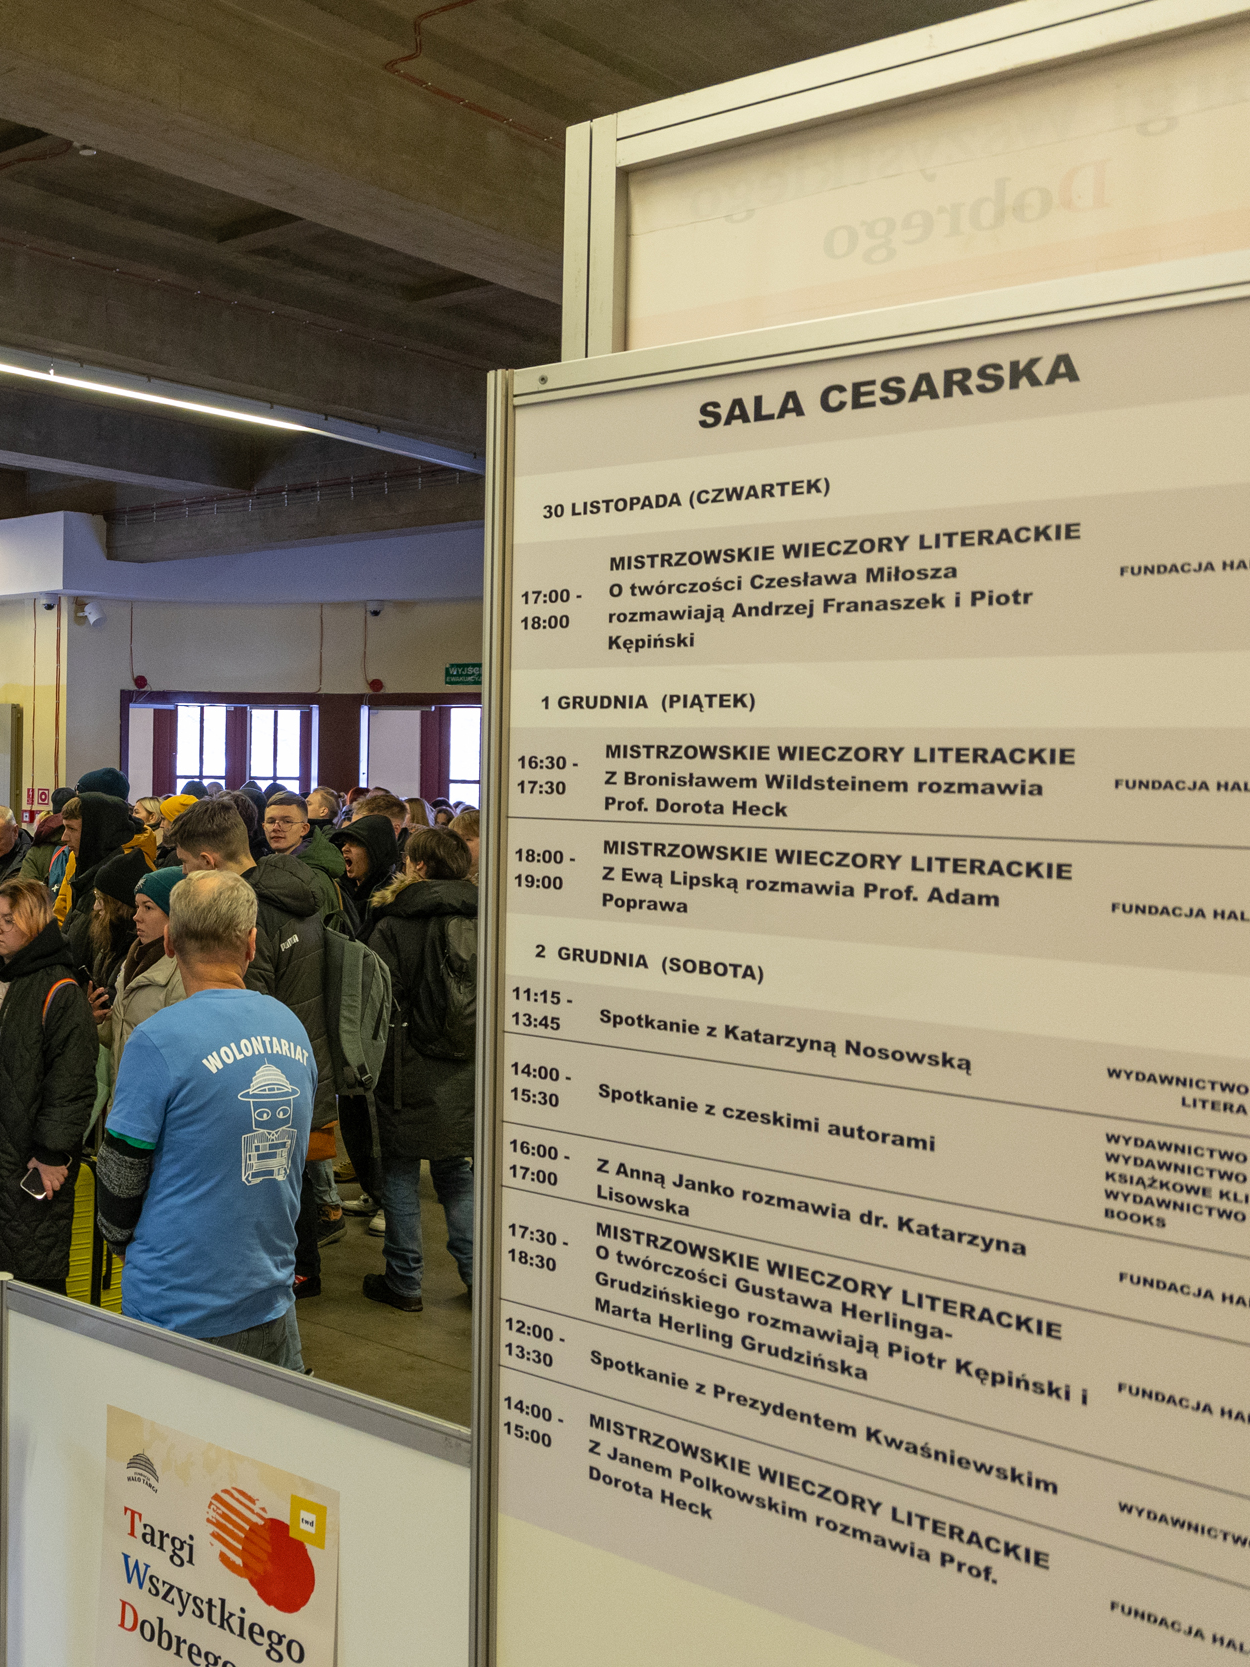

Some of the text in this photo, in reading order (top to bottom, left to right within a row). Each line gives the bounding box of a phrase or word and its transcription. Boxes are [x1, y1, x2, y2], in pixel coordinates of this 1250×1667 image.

[698, 352, 1081, 430] SALA CESARSKA
[542, 477, 831, 520] 30 LISTOPADA (CZWARTEK)
[609, 522, 1081, 572] MISTRZOWSKIE WIECZORY LITERACKIE
[608, 565, 958, 598] O twórczości Czesława Miłosza
[1119, 559, 1250, 577] FUNDACJA HA
[521, 588, 571, 605] 17:00
[608, 588, 1034, 624] rozmawiają Andrzej Franaszek i Piotr
[520, 614, 570, 631] 18:00
[607, 632, 695, 654] Kępiński
[541, 692, 756, 713] 1 GRUDNIA (PIĄTEK)
[517, 754, 567, 771] 16:30
[605, 743, 1076, 766] MISTRZOWSKIE WIECZORY LITERACKIE
[517, 779, 567, 796] 17:30
[604, 770, 1044, 797] Z Bronisławem Wildsteinem rozmawia
[1114, 778, 1211, 792] FUNDACJA
[604, 796, 788, 818] Prof. Dorota Heck
[514, 847, 564, 865] 18:00
[603, 839, 1073, 881] MISTRZOWSKIE WIECZORY LITERACKIE
[514, 873, 564, 891] 19:00
[601, 865, 1000, 908] Z Ewą Lipską rozmawia Prof. Adam
[602, 892, 688, 914] Poprawa
[1111, 901, 1207, 920] FUNDACJA
[534, 943, 764, 986] 2 GRUDNIA (SOBOTA)
[512, 986, 562, 1006] 11:15
[511, 1011, 561, 1032] 13:45
[201, 1035, 310, 1074] WOLONTARIAT
[599, 1008, 972, 1077] Spotkanie z Katarzyną Nosowską
[510, 1061, 560, 1083] 14:00
[1106, 1066, 1250, 1096] WYDAWNICTWO
[510, 1086, 560, 1108] 15:30
[1181, 1095, 1248, 1117] LITERA
[598, 1082, 936, 1153] Spotkanie z czeskimi autorami
[509, 1138, 559, 1161] 16:00
[1105, 1132, 1248, 1165] WYDAWNICTWO
[509, 1163, 559, 1187] 17:00
[1104, 1151, 1248, 1185] WYDAWNICTWO
[1104, 1170, 1212, 1199] KSIĄŻKOWE
[596, 1183, 690, 1218] Lisowska
[596, 1157, 1027, 1257] Z Anną Janko rozmawia dr. Katarzyna
[1104, 1187, 1247, 1224] WYDAWNICTWO
[1104, 1207, 1167, 1229] BOOKS
[508, 1222, 558, 1247] 17:30
[507, 1247, 557, 1273] 18:30
[595, 1221, 1062, 1341] MISTRZOWSKIE WIECZORY LITERACKIE
[595, 1244, 953, 1341] O twórczości Gustawa Herlinga-
[1118, 1271, 1250, 1309] FUNDACJA HA
[505, 1316, 554, 1343] 12:00
[594, 1270, 1088, 1407] Grudzińskiego rozmawiają Piotr Kępiński i
[594, 1296, 868, 1382] Marta Herling Grudzińska
[504, 1341, 554, 1368] 13:30
[504, 1395, 553, 1423] 14:00
[1117, 1381, 1250, 1426] FUNDACJA HA
[503, 1420, 553, 1449] 15:00
[590, 1349, 1059, 1496] Spotkanie z Prezydentem Kwaśniewskim
[142, 1479, 158, 1493] TARGI
[588, 1464, 713, 1521] Dorota Heck
[589, 1412, 1050, 1571] MISTRZOWSKIE WIECZORY LITERACKIE
[301, 1517, 315, 1528] twd
[587, 1438, 998, 1586] Z Janem Polkowskim rozmawia Prof.
[1118, 1500, 1250, 1549] WYDAWNICTW
[123, 1505, 196, 1567] Targi
[121, 1551, 307, 1665] Wszystkiego
[1109, 1600, 1206, 1642] FUNDACJA
